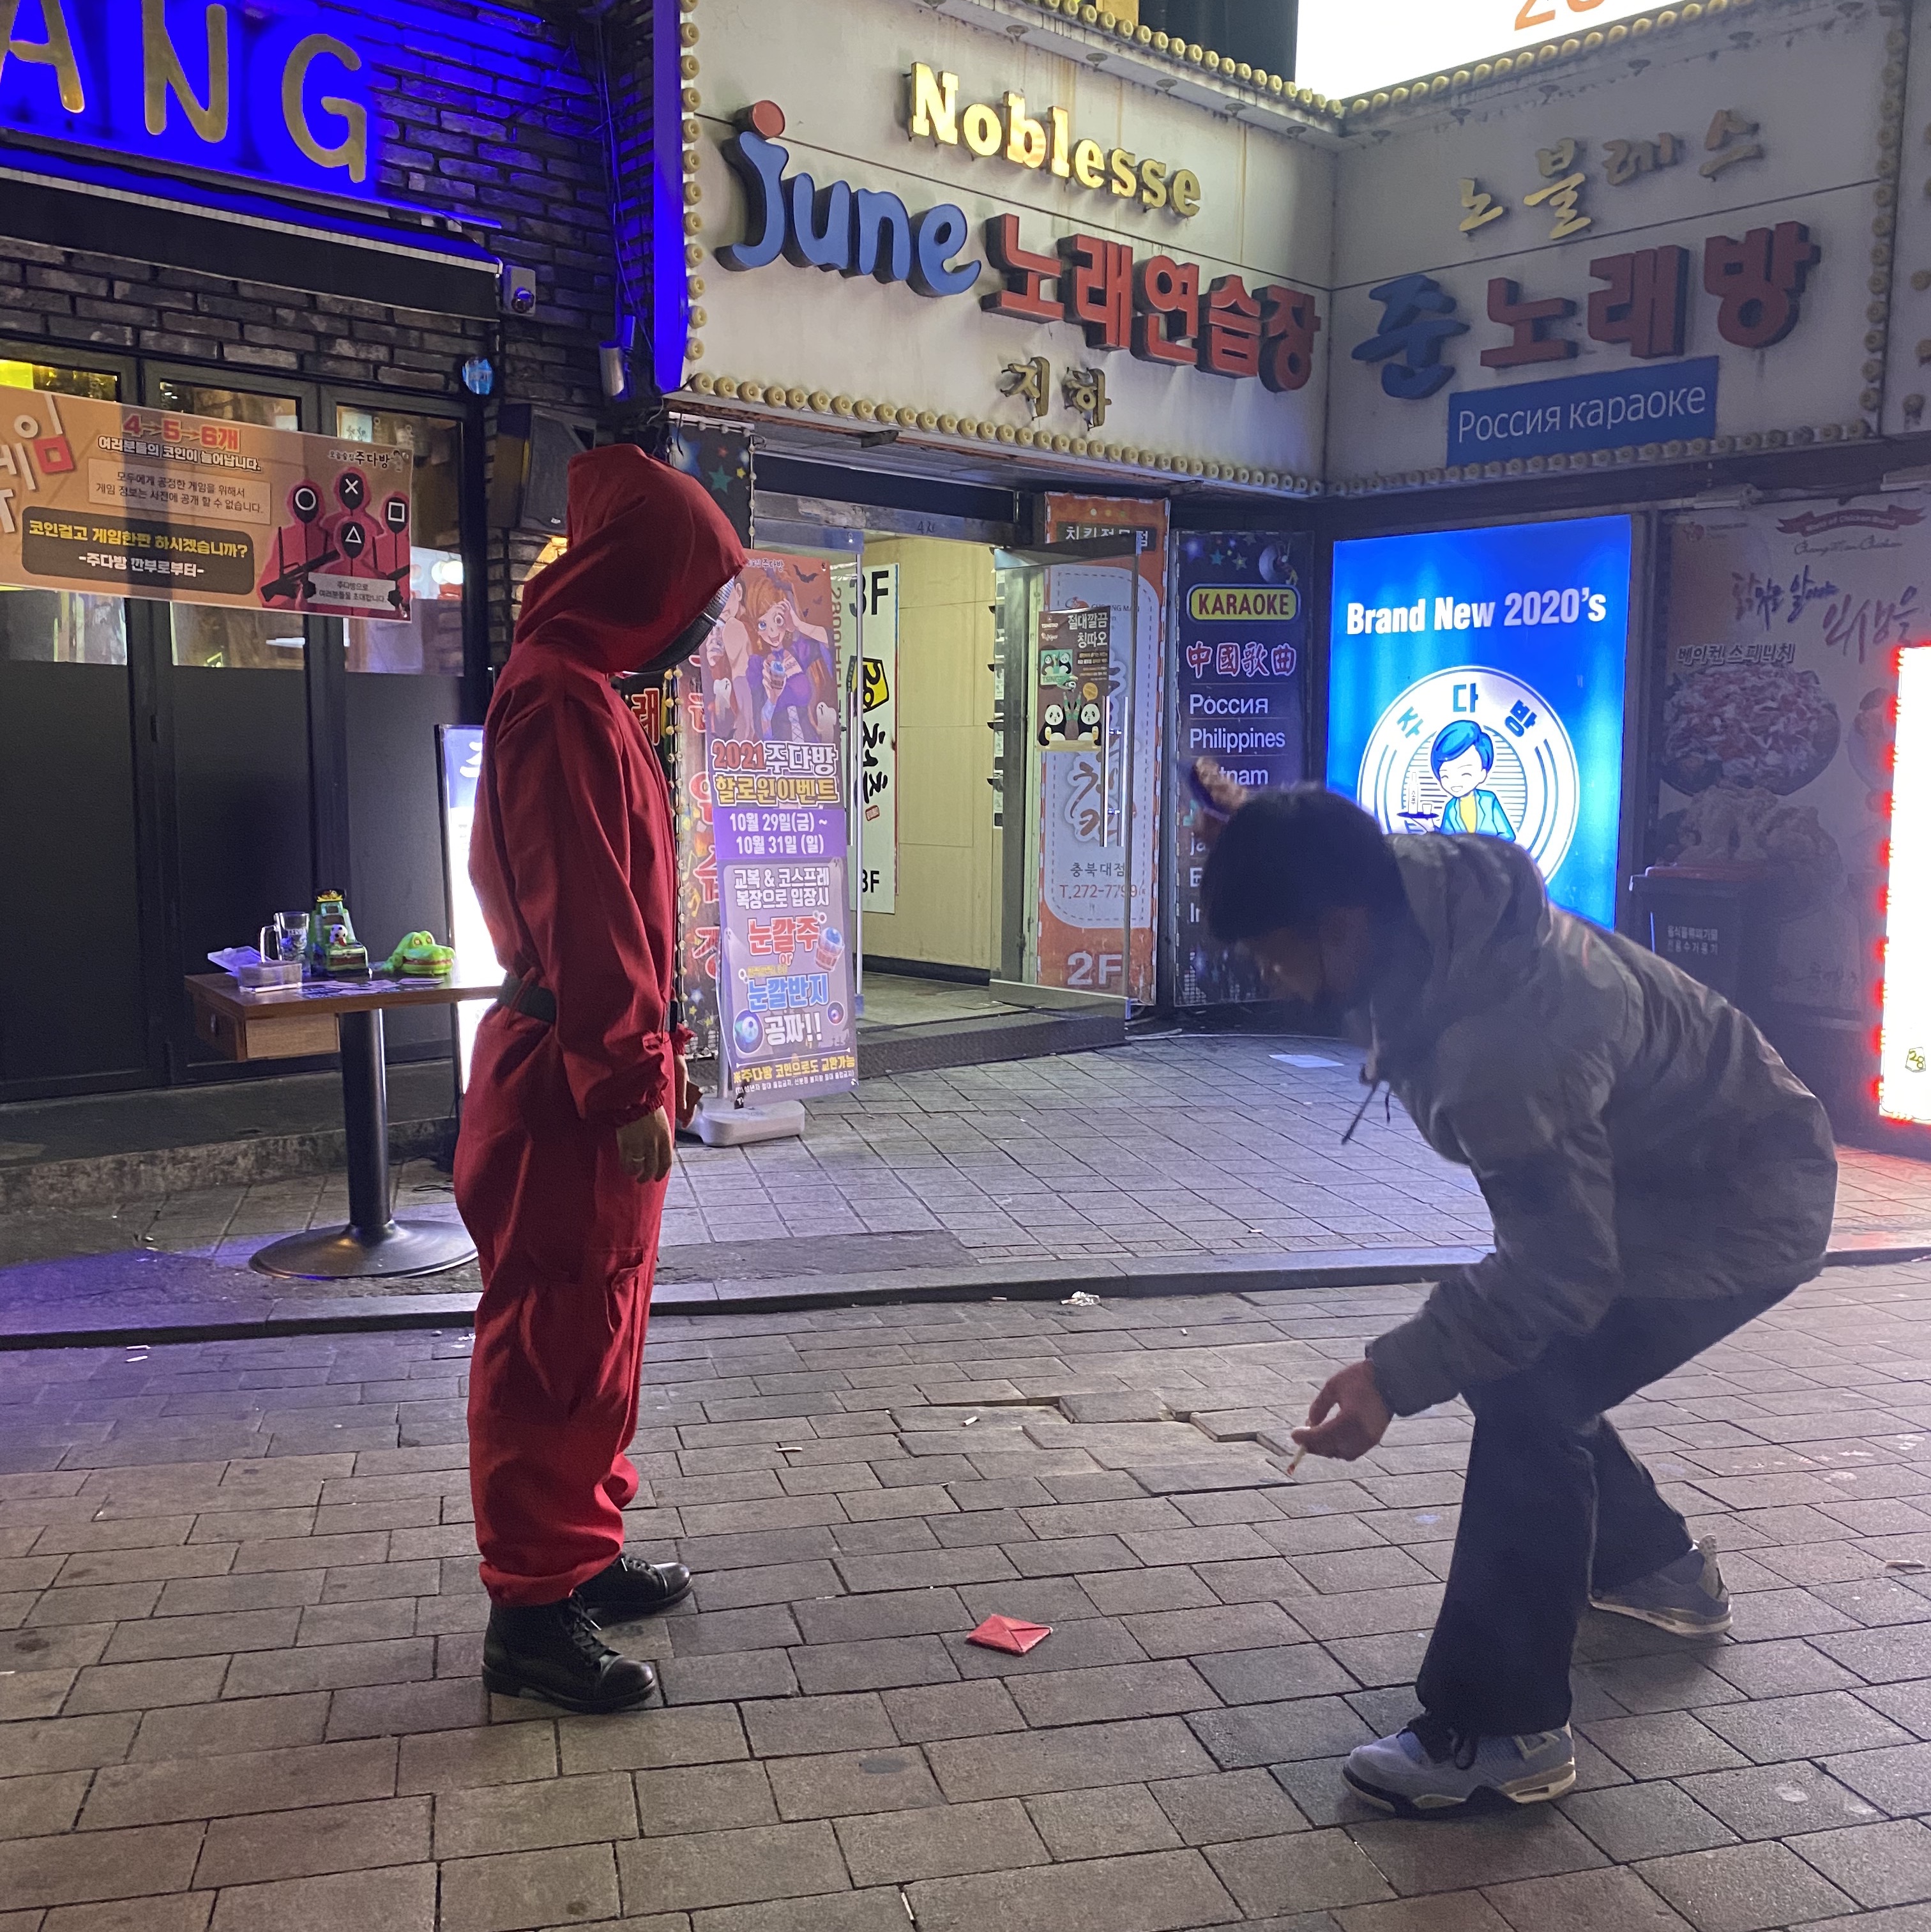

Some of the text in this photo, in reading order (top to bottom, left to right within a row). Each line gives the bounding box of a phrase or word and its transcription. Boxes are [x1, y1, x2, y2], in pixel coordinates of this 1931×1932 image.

[911, 62, 1201, 218] Noblesse
[1459, 109, 1764, 239] 노블레스
[981, 213, 1321, 393] 노래연습장
[1458, 384, 1706, 443] Россия караоке
[123, 414, 240, 452] 4 5 6개
[98, 436, 262, 472] 여러분들의 코인이 늘어납니다.
[355, 451, 391, 468] 주다방
[96, 482, 116, 495] 게임
[119, 486, 147, 500] 정보는
[150, 489, 178, 503] 사전에
[181, 494, 199, 506] 공개
[202, 496, 211, 507] 할
[214, 498, 223, 508] 수
[117, 471, 245, 498] 모두에게 공정한 게임을 위해서
[29, 520, 248, 558] 코인걸고 게임한판 하시겠습니까?
[849, 570, 889, 618] 3F
[1199, 593, 1289, 615] KARAOKE
[1068, 612, 1109, 630] 절대깔끔
[1347, 588, 1606, 635] Brand New 2020's
[1077, 631, 1107, 648] 칭따오
[1186, 641, 1296, 679] 中國歌曲
[1190, 694, 1268, 714] Россия
[1397, 682, 1537, 738] 주다방
[1190, 728, 1285, 754] Philippines
[715, 774, 839, 807] 할로윈이벤트
[730, 812, 759, 832] 10월
[762, 812, 814, 832] 29일(금)
[736, 834, 824, 855] 10월 31일 (일)
[734, 867, 829, 889] 교복 & 코스프레
[1070, 862, 1125, 878] 충북대점
[736, 886, 829, 909] 복장으로 입장시
[748, 915, 820, 955] 눈깔주
[778, 952, 793, 966] or
[1067, 952, 1122, 986] 2F
[748, 973, 829, 1013] 눈깔반지
[764, 1012, 822, 1046] 공짜!!
[775, 1060, 819, 1078] 코인으로도
[821, 1054, 855, 1072] 교환가능
[1909, 1050, 1924, 1069] 28
